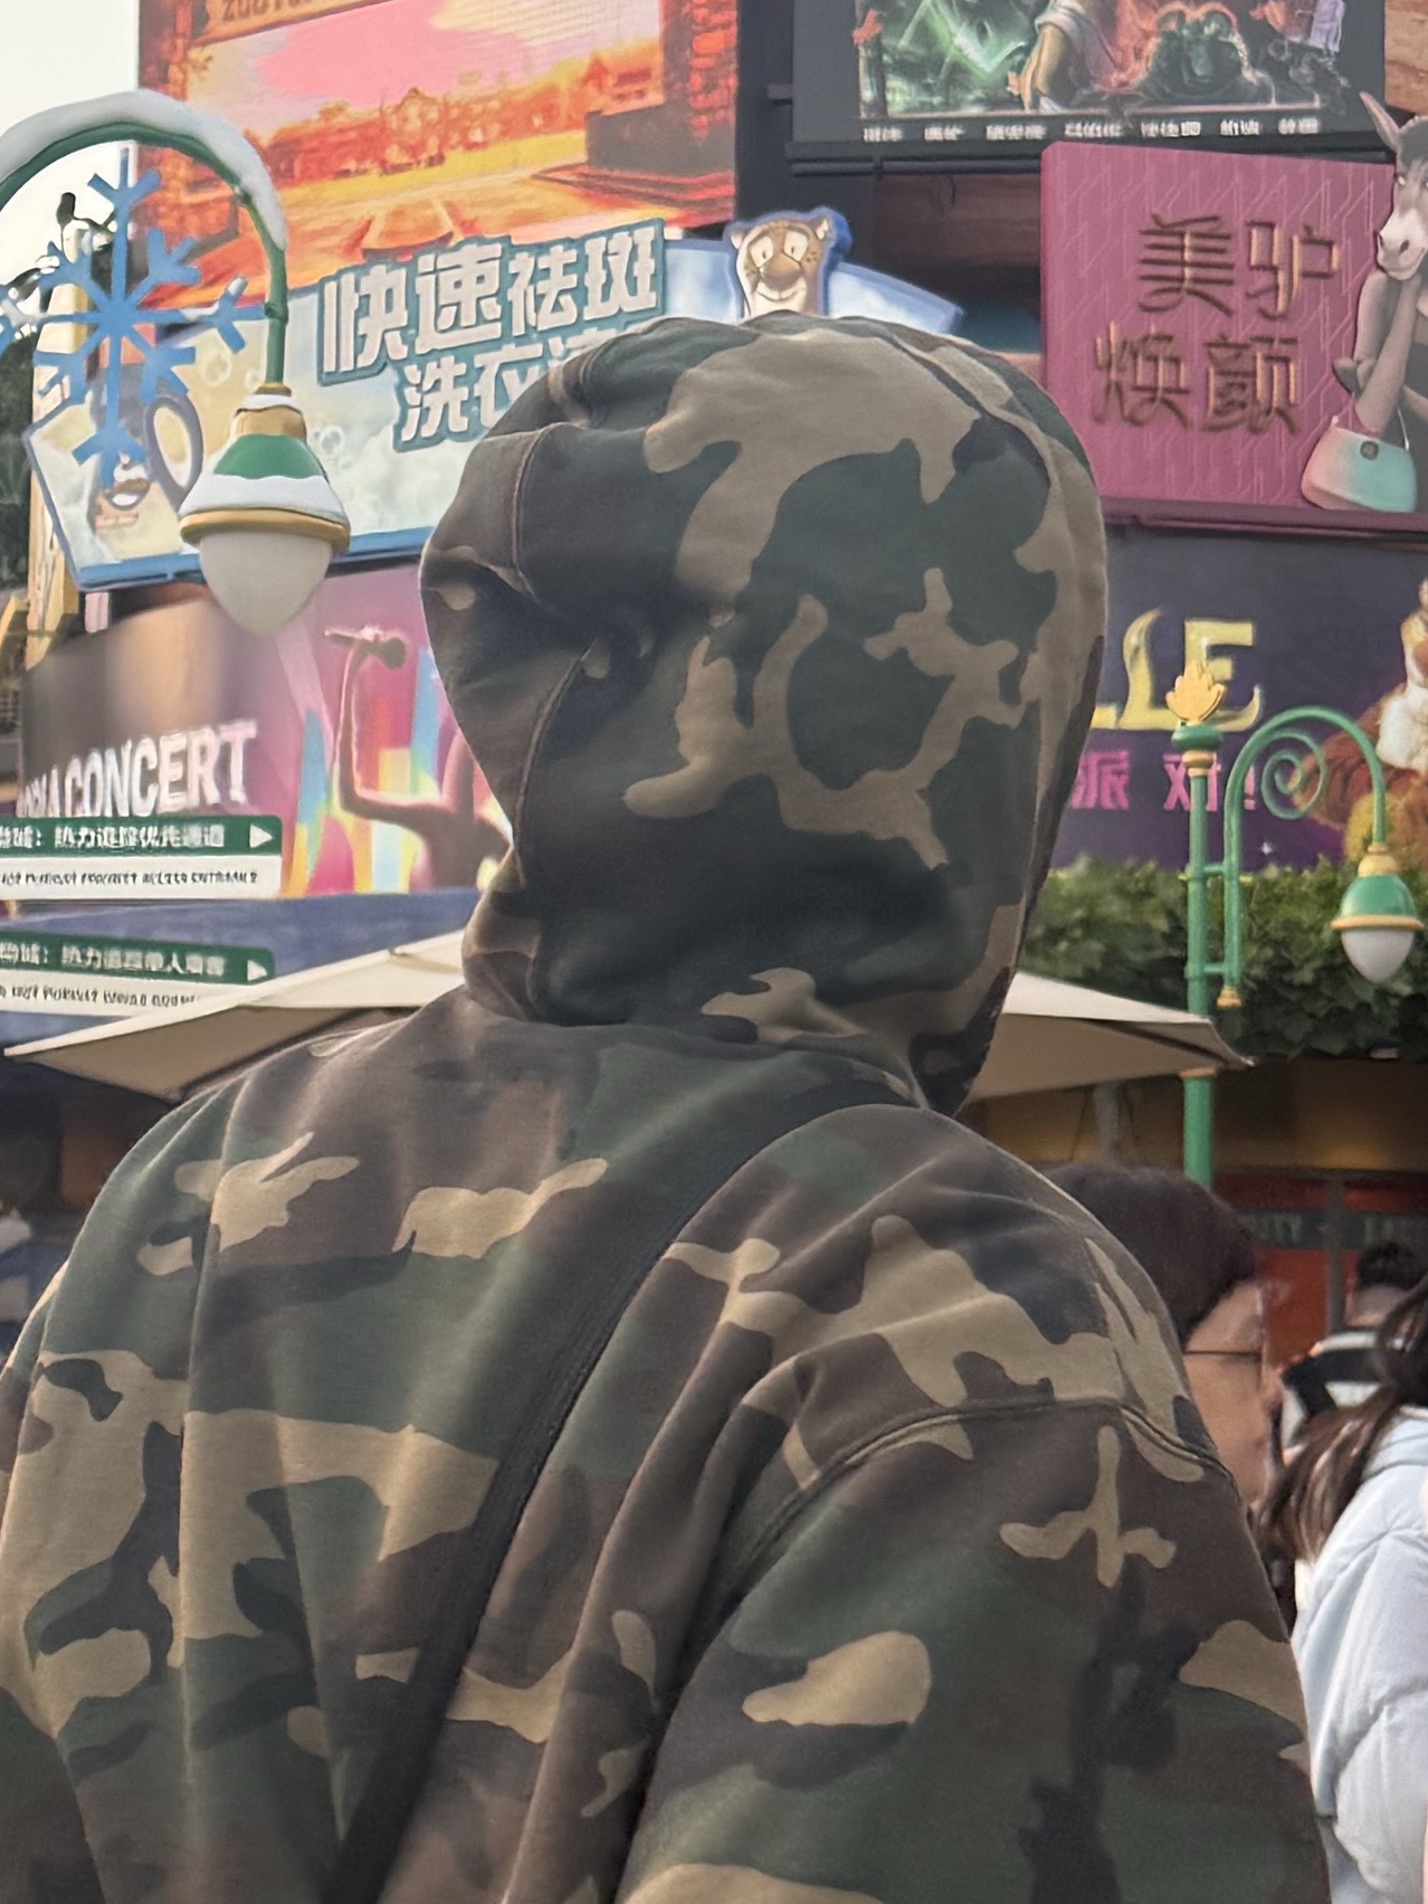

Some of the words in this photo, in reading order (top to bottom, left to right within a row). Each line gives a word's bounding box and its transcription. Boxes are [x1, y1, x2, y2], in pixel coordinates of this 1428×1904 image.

[323, 226, 657, 374] 快速祛斑
[1138, 213, 1340, 320] 美驴
[64, 718, 258, 818] CONCERT
